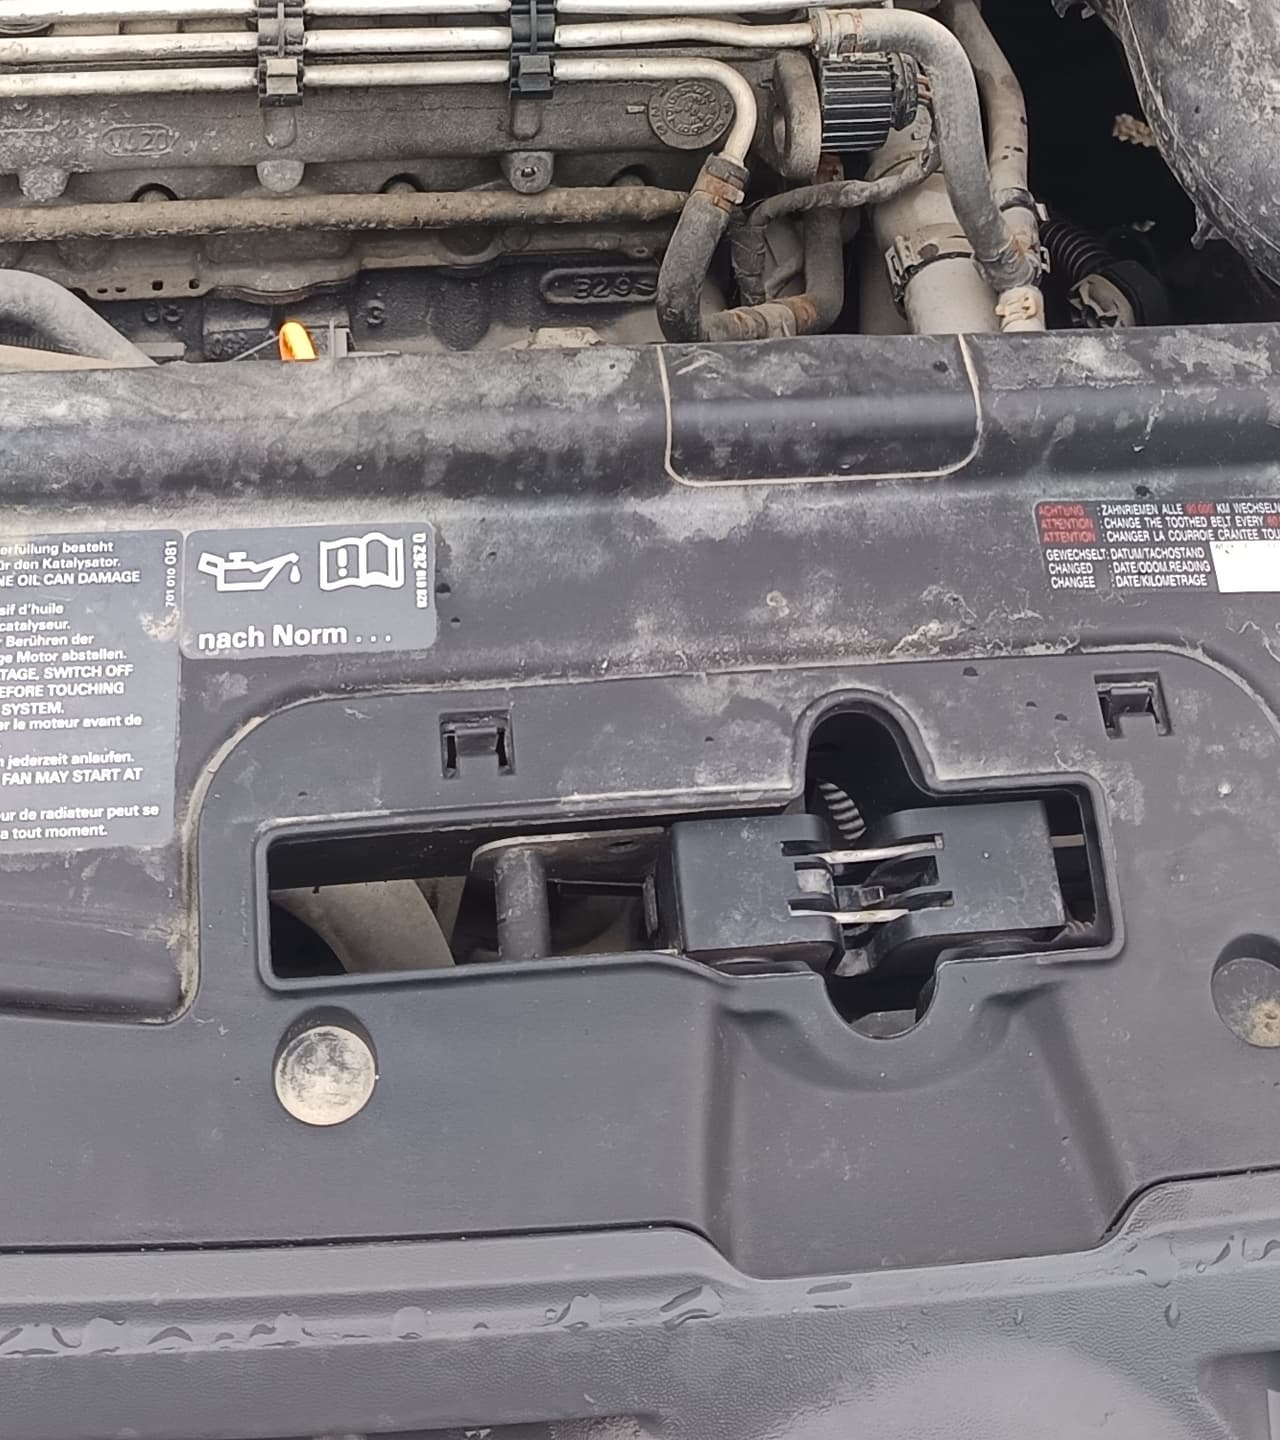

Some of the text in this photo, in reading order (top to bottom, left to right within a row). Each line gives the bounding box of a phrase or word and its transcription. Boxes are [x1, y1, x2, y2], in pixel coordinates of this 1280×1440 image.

[1039, 504, 1084, 517] ACHTUNG
[1162, 503, 1183, 515] ALLE
[1216, 503, 1231, 514] KM
[1041, 517, 1093, 529] ATTENTION
[1144, 517, 1162, 528] THE
[1166, 516, 1207, 528] TOOTHED
[1211, 515, 1231, 527] BELT
[1235, 515, 1264, 527] EVERY
[1043, 531, 1096, 543] ATTENTION
[1153, 530, 1165, 541] LA
[1168, 529, 1215, 541] COURROIE
[1217, 528, 1263, 540] CRANTEE
[62, 541, 114, 553] besteht
[14, 559, 39, 570] den
[42, 557, 121, 570] Katalysator.
[412, 544, 427, 569] 262
[164, 540, 178, 607] 701 010 081
[1049, 563, 1093, 574] CHANGED
[17, 574, 41, 586] OIL
[43, 573, 74, 585] CAN
[78, 571, 141, 584] DAMAGE
[1051, 576, 1096, 589] CHANGEE
[18, 602, 64, 615] d'huile
[6, 635, 68, 648] Berühren
[71, 633, 94, 645] der
[198, 625, 265, 650] nach
[273, 624, 347, 647] Norm
[17, 651, 59, 663] Motor
[62, 648, 127, 661] abstellen.
[43, 665, 102, 679] SWITCH
[105, 664, 134, 677] OFF
[47, 682, 124, 696] TOUCHING
[1, 702, 64, 716] SYSTEM.
[13, 718, 26, 730] le
[29, 717, 80, 729] moteur
[83, 716, 121, 728] avant
[124, 713, 142, 726] de
[7, 753, 68, 770] jederzeit
[71, 750, 135, 765] anlaufen.
[2, 771, 32, 785] FAN
[35, 770, 69, 784] MAY
[72, 768, 121, 783] START
[123, 767, 143, 780] AT
[19, 808, 36, 821] de
[40, 806, 104, 820] radiateur
[107, 805, 139, 820] peut
[142, 806, 159, 816] se
[0, 831, 9, 840] a
[12, 827, 42, 839] tout
[45, 825, 108, 838] moment.
